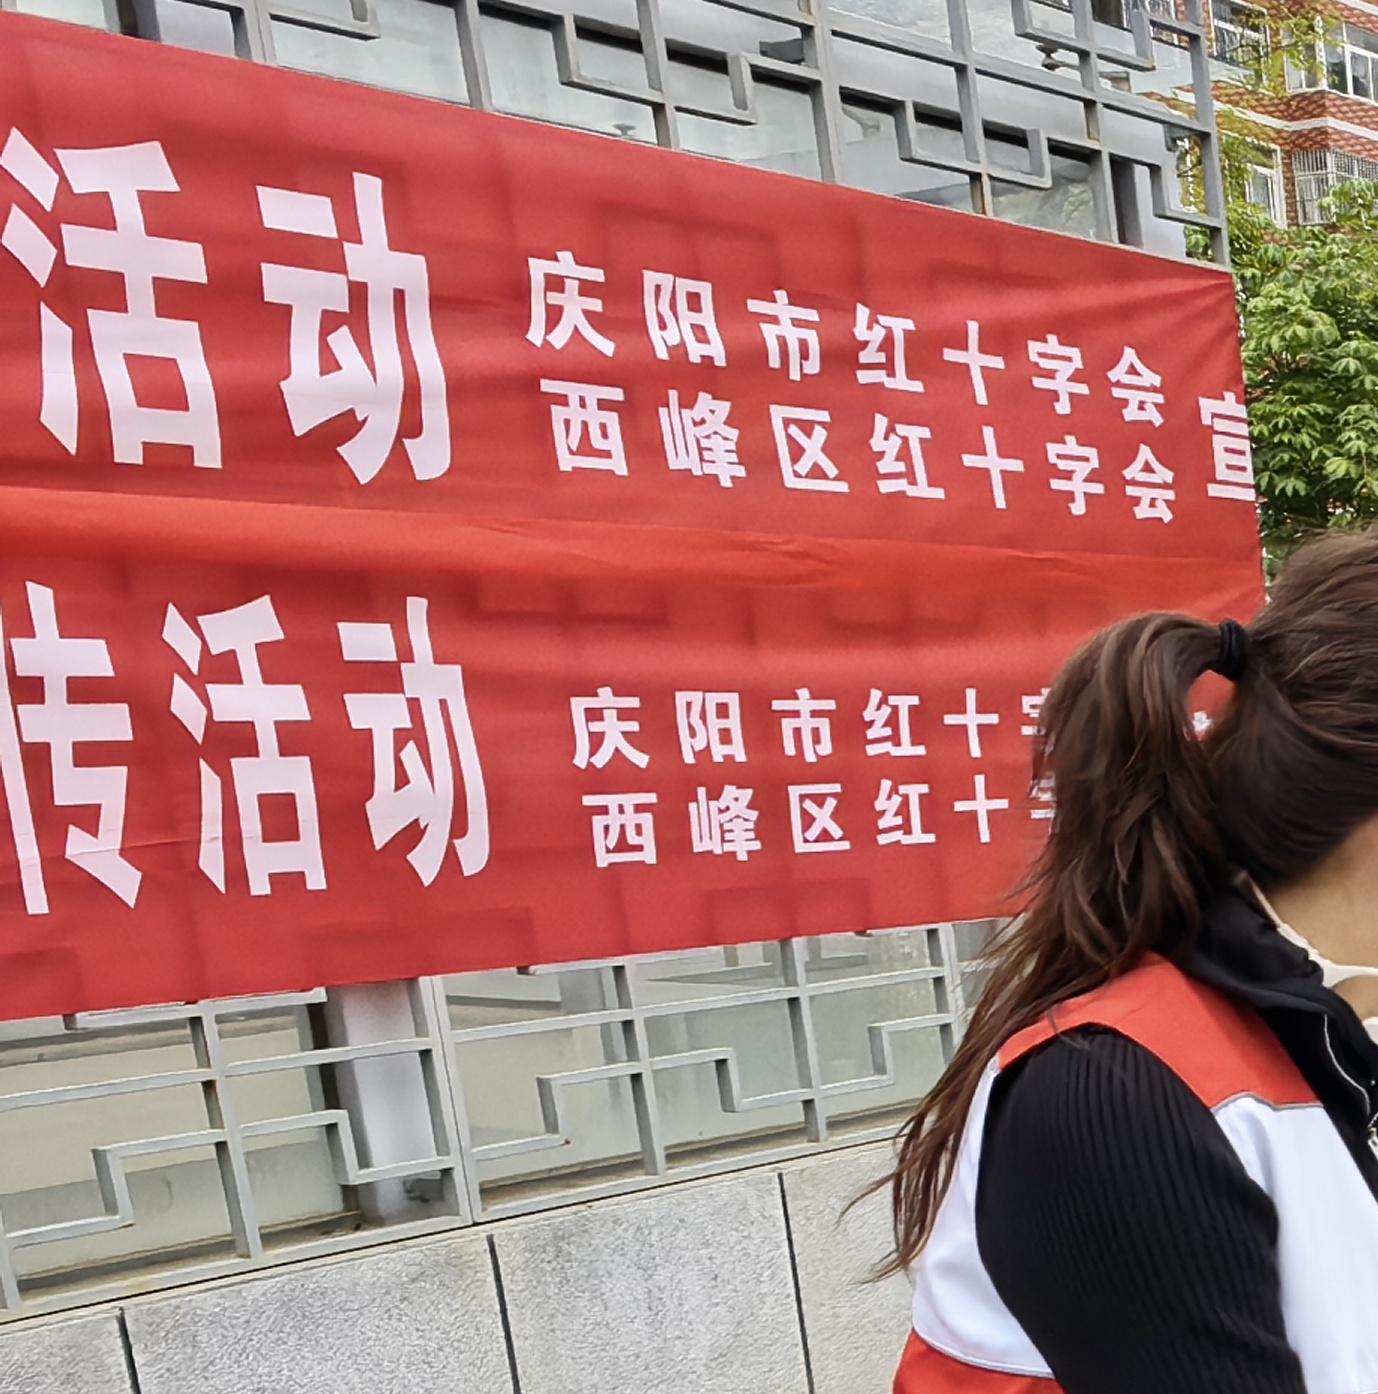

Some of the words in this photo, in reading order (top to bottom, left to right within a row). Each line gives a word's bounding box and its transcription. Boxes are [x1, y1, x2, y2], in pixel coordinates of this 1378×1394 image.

[0, 125, 452, 484] 活动
[525, 250, 1166, 427] 庆阳市红十字会
[539, 378, 1176, 523] 西峰区红十字会
